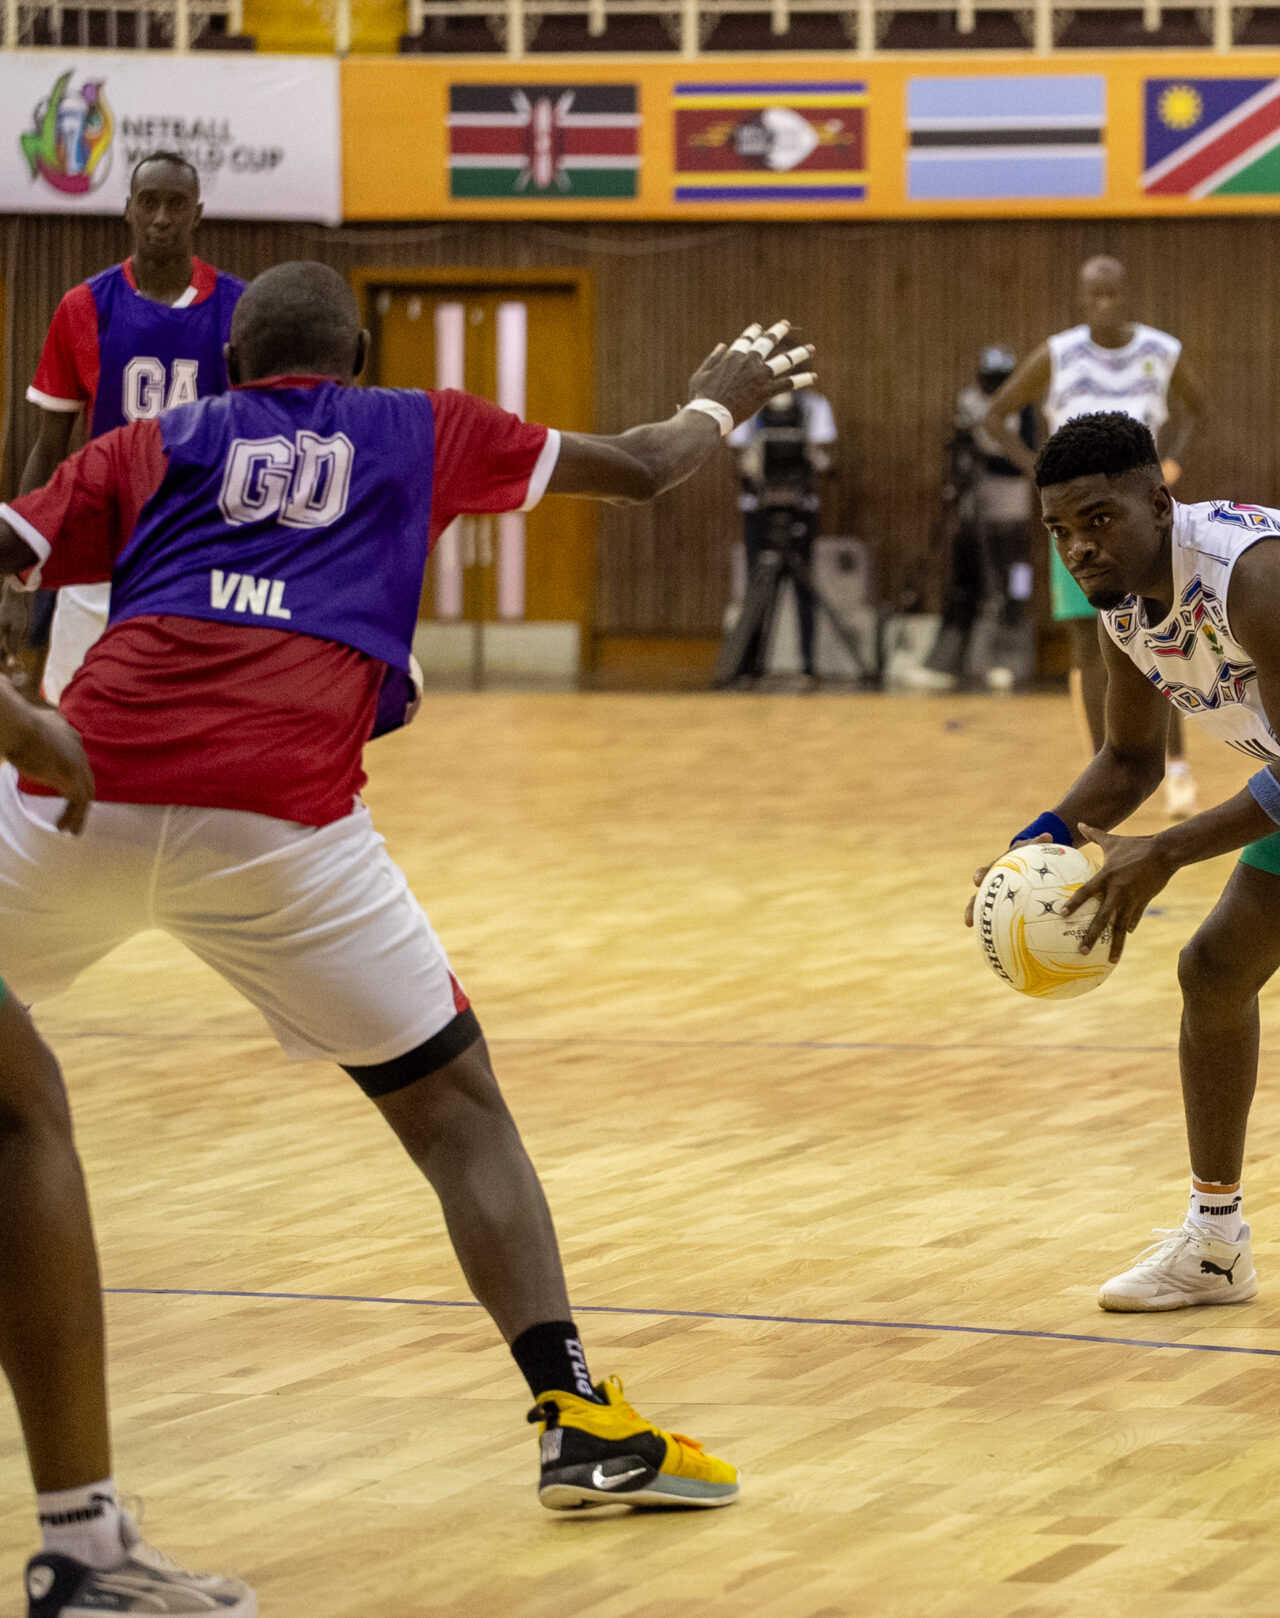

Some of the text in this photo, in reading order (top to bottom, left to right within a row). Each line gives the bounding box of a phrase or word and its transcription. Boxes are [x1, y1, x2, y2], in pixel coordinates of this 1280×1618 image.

[122, 356, 198, 423] GA
[218, 430, 354, 529] GD
[211, 569, 291, 619] VNL
[982, 873, 1014, 984] GILBERT
[1199, 1202, 1239, 1216] PUMA
